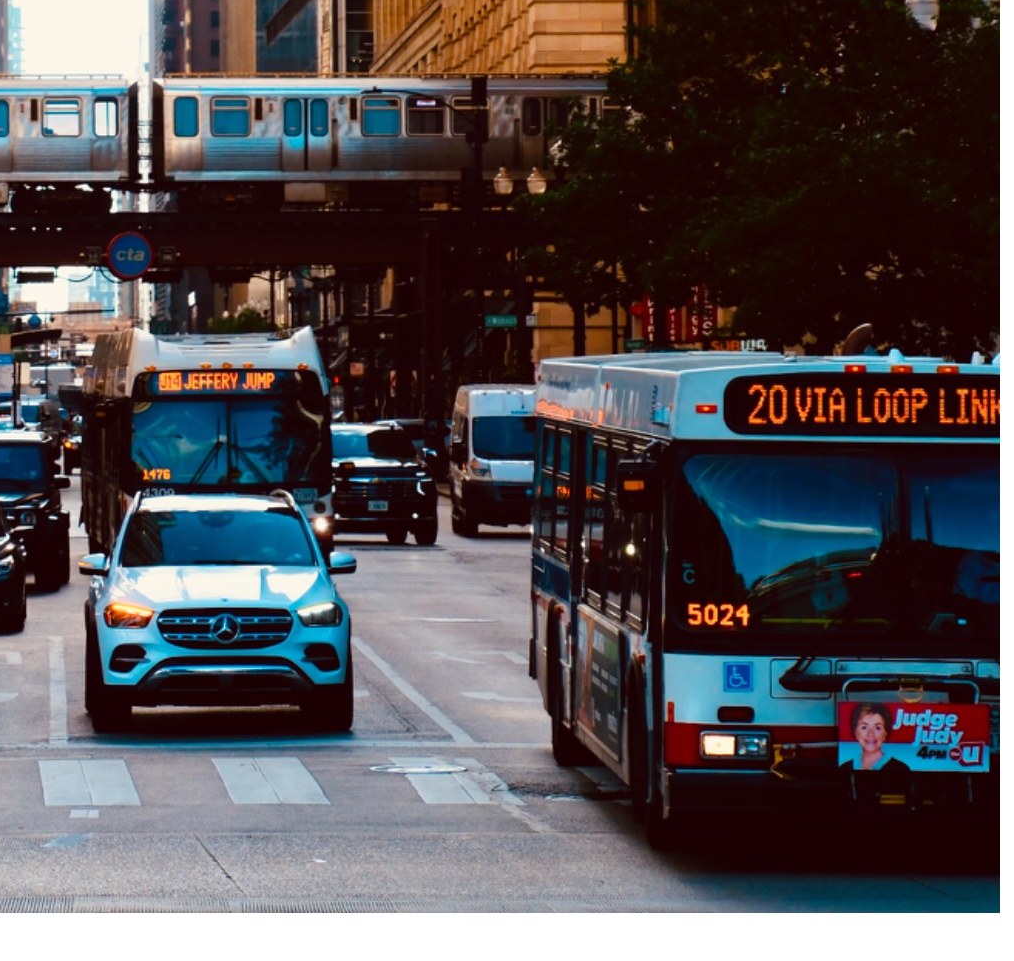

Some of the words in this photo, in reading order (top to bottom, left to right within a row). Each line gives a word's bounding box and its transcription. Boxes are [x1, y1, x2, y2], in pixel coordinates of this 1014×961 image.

[116, 247, 145, 262] cta
[184, 373, 238, 389] JEFFERY
[242, 373, 275, 389] JUMP
[748, 384, 787, 425] 20
[795, 387, 846, 422] VIA
[857, 388, 928, 424] LOOP
[142, 469, 171, 481] 1476
[688, 604, 750, 626] 5024
[893, 708, 959, 730] Judge
[912, 725, 964, 748] Judy
